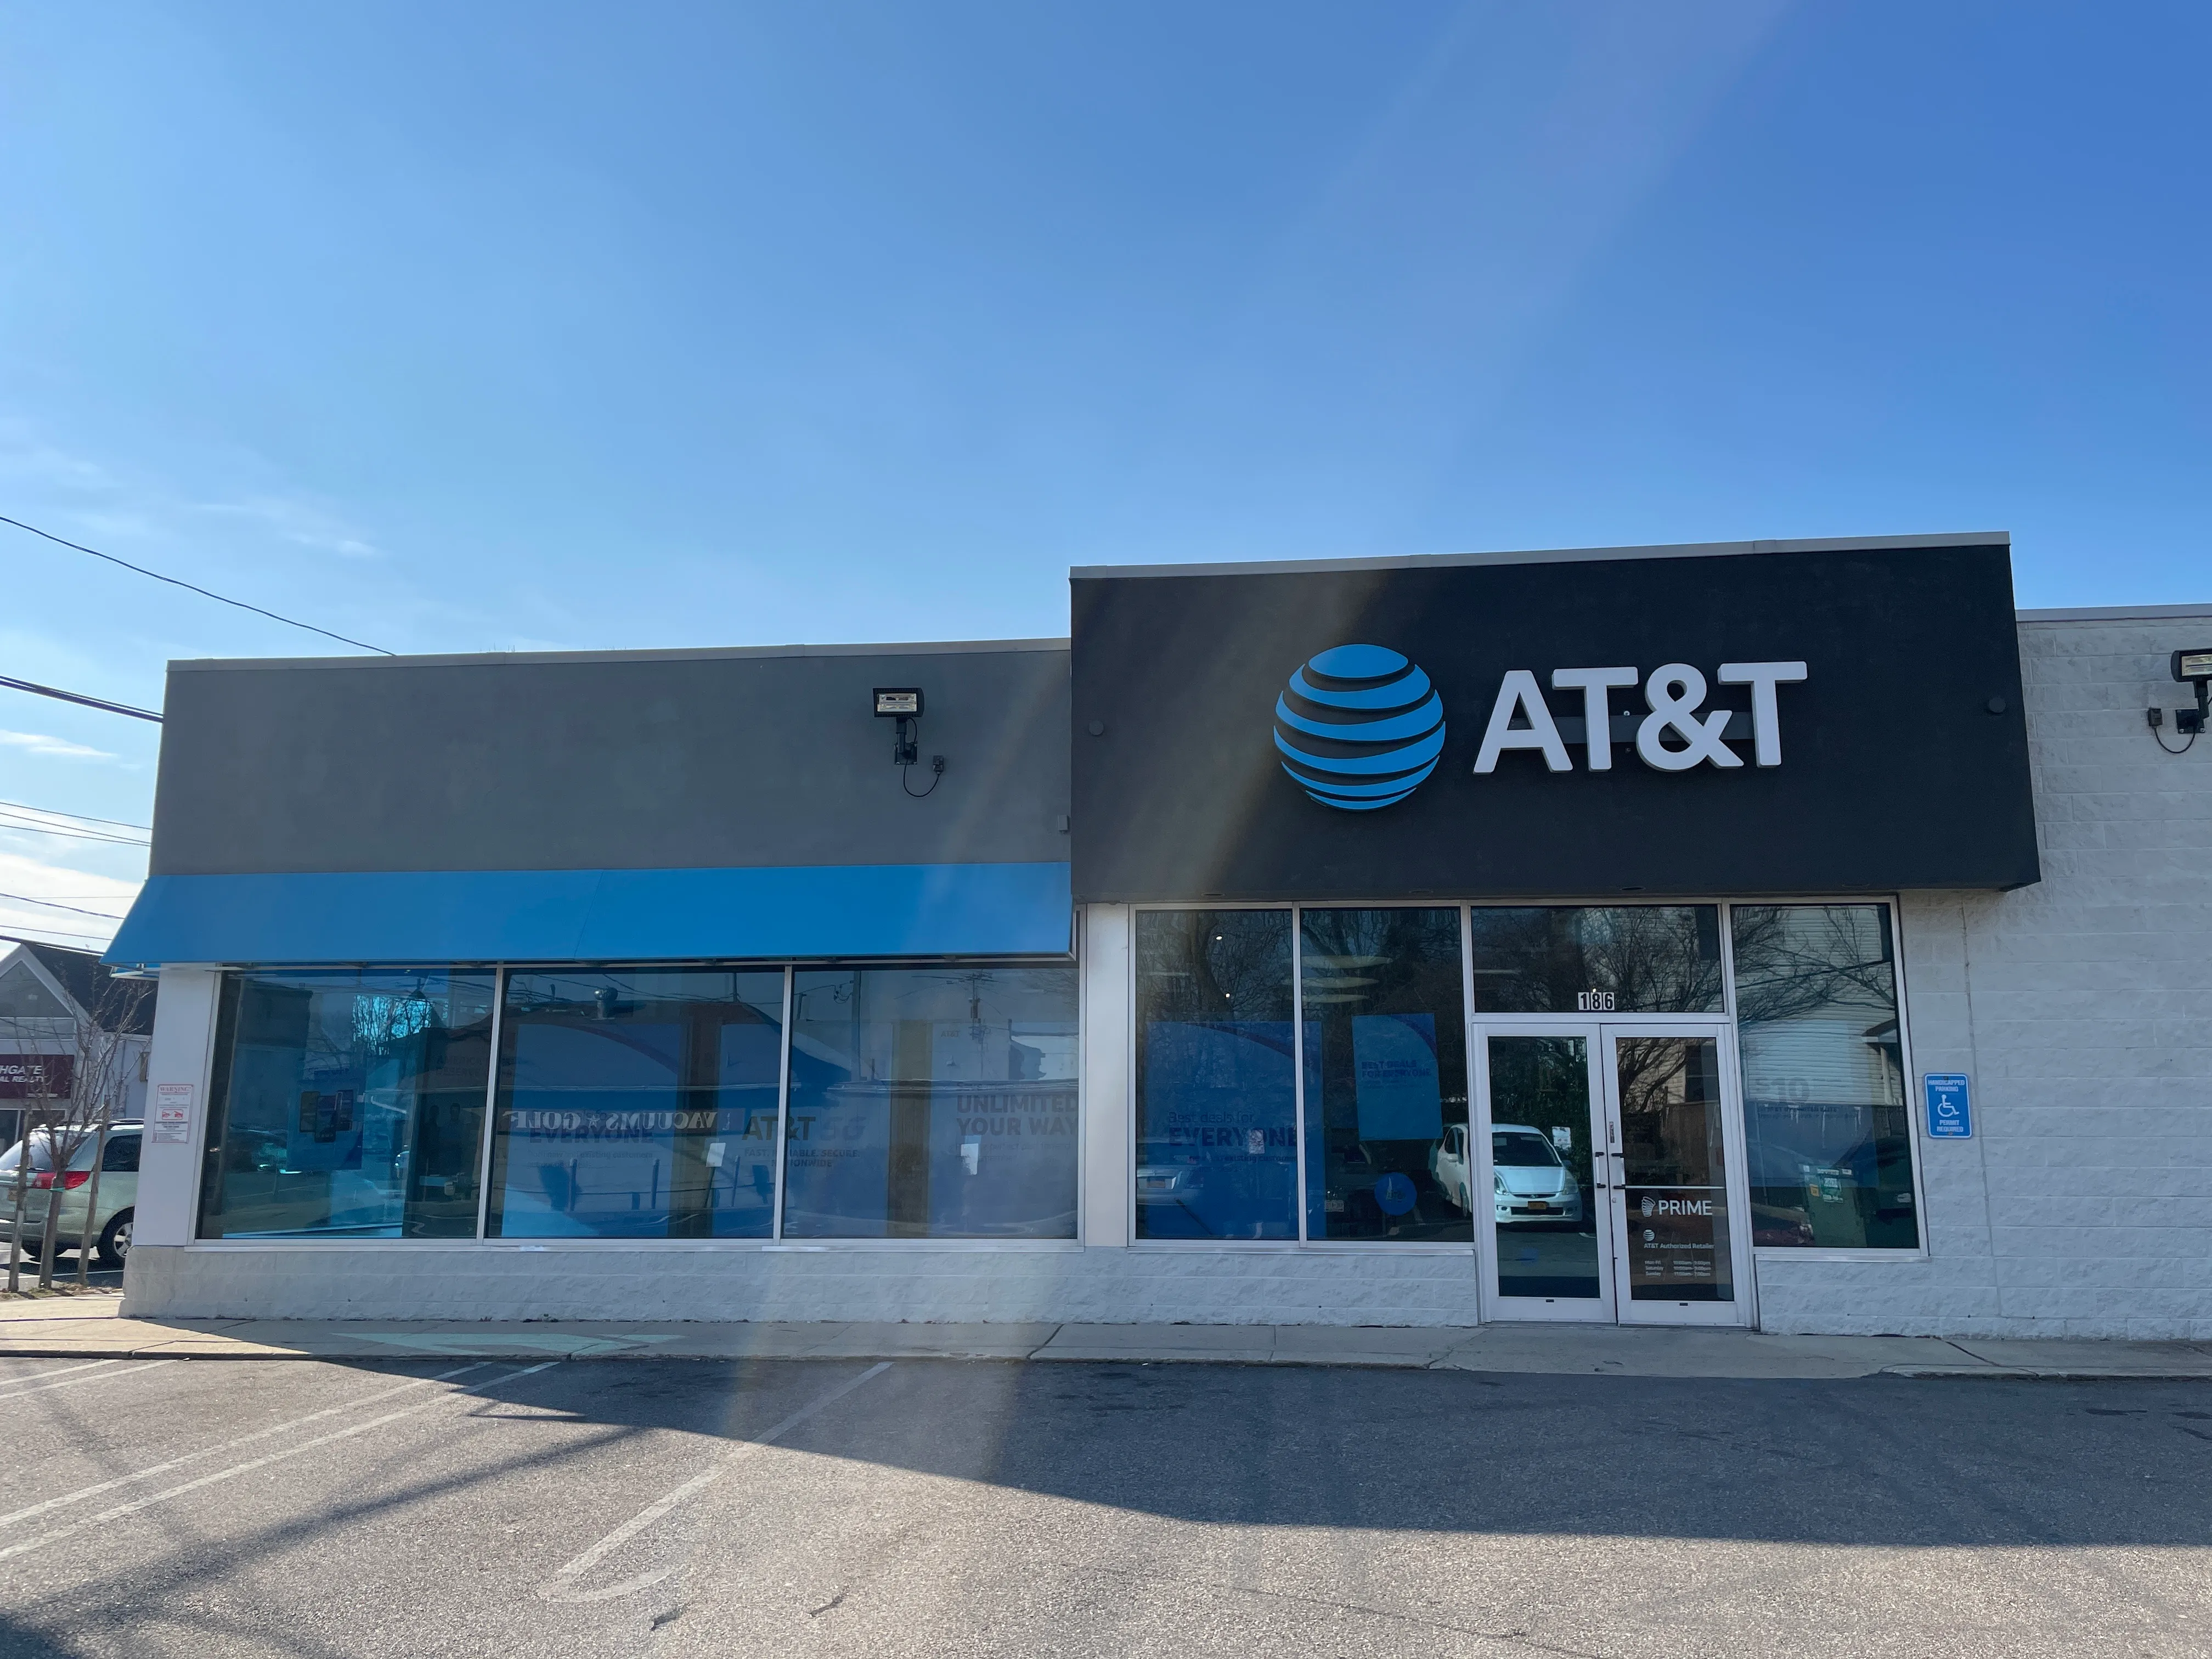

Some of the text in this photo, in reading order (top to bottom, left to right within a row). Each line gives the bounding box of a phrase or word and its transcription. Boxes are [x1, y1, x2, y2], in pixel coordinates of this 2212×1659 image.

[1474, 661, 1807, 775] AT&T
[1581, 993, 1613, 1009] 186
[957, 1094, 1078, 1113] UNLIMITED
[529, 1125, 654, 1144] EVERYONE
[956, 1117, 1078, 1136] YOUR WAY
[1658, 1200, 1713, 1216] PRIME
